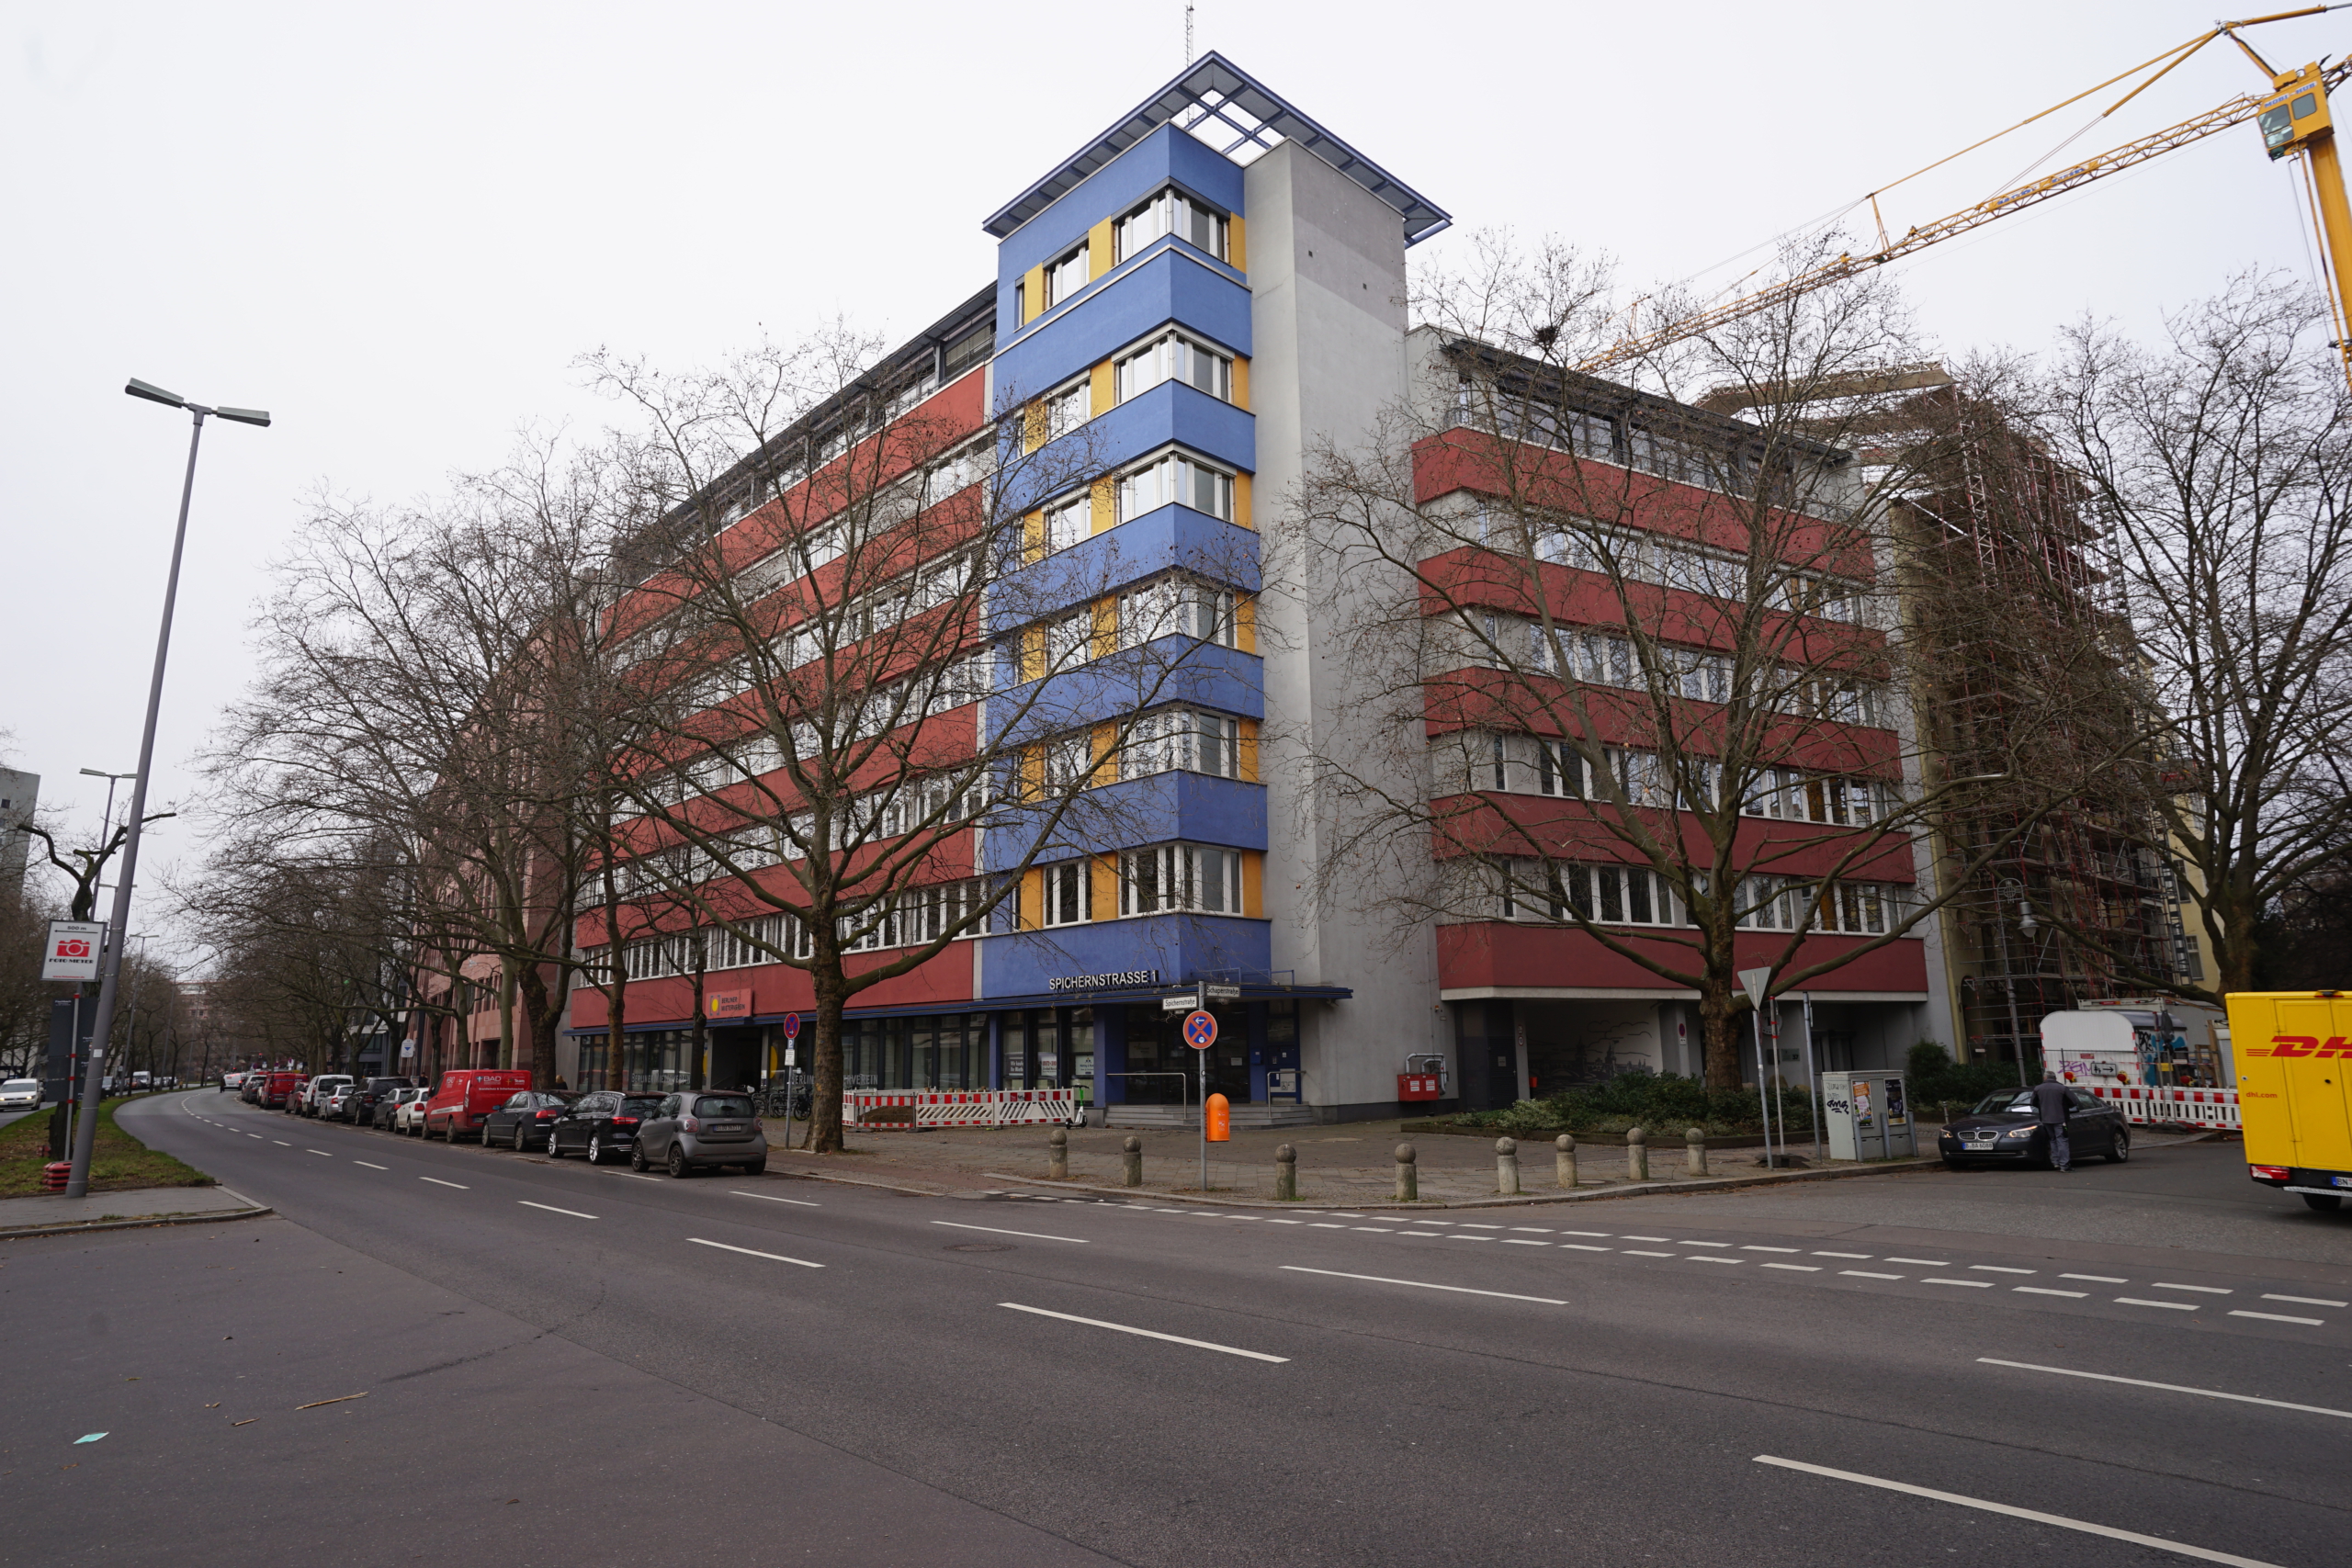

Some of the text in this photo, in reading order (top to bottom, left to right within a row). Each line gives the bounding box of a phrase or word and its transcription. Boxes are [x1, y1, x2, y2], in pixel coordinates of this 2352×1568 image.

[1048, 970, 1158, 990] SPICHERNSTRASSE 1
[1165, 998, 1195, 1008] Spichernstraße
[2270, 1035, 2352, 1059] DH
[791, 1074, 815, 1085] BERLIN
